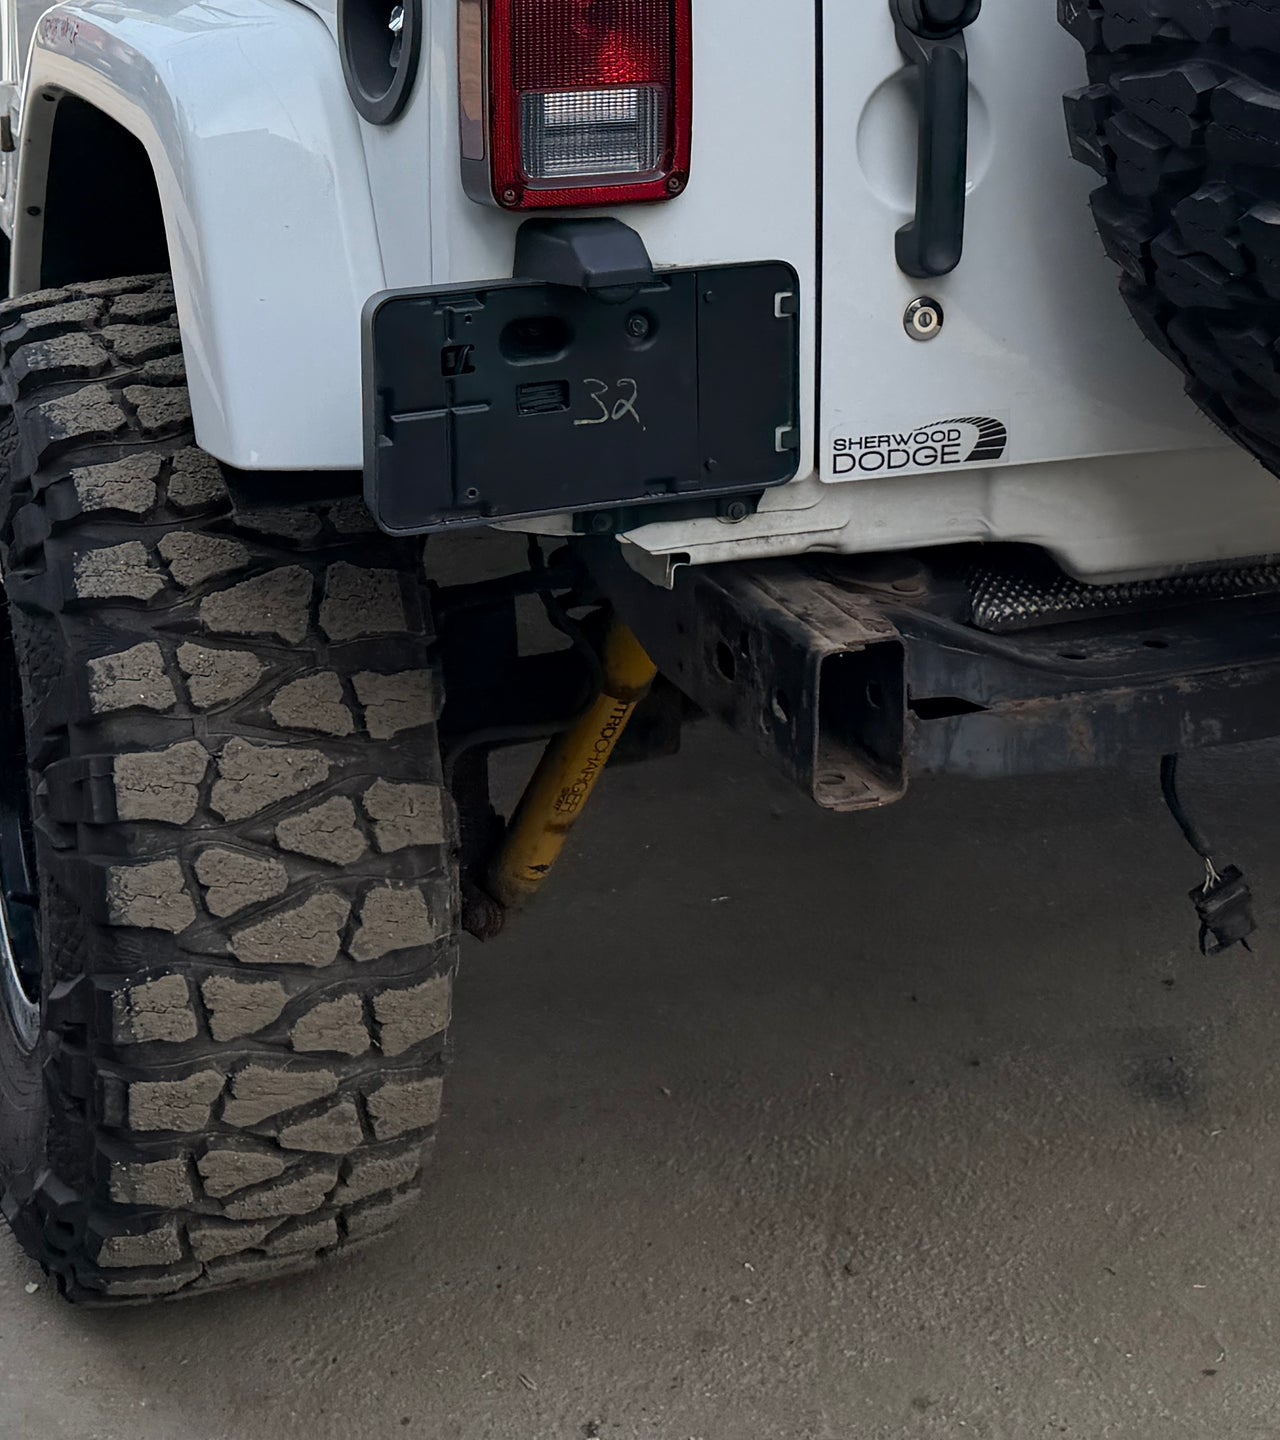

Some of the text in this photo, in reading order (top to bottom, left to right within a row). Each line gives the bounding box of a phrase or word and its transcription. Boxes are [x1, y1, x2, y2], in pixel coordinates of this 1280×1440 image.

[572, 377, 643, 427] 32
[832, 428, 962, 452] SHERWOOD
[832, 442, 962, 475] DODGE
